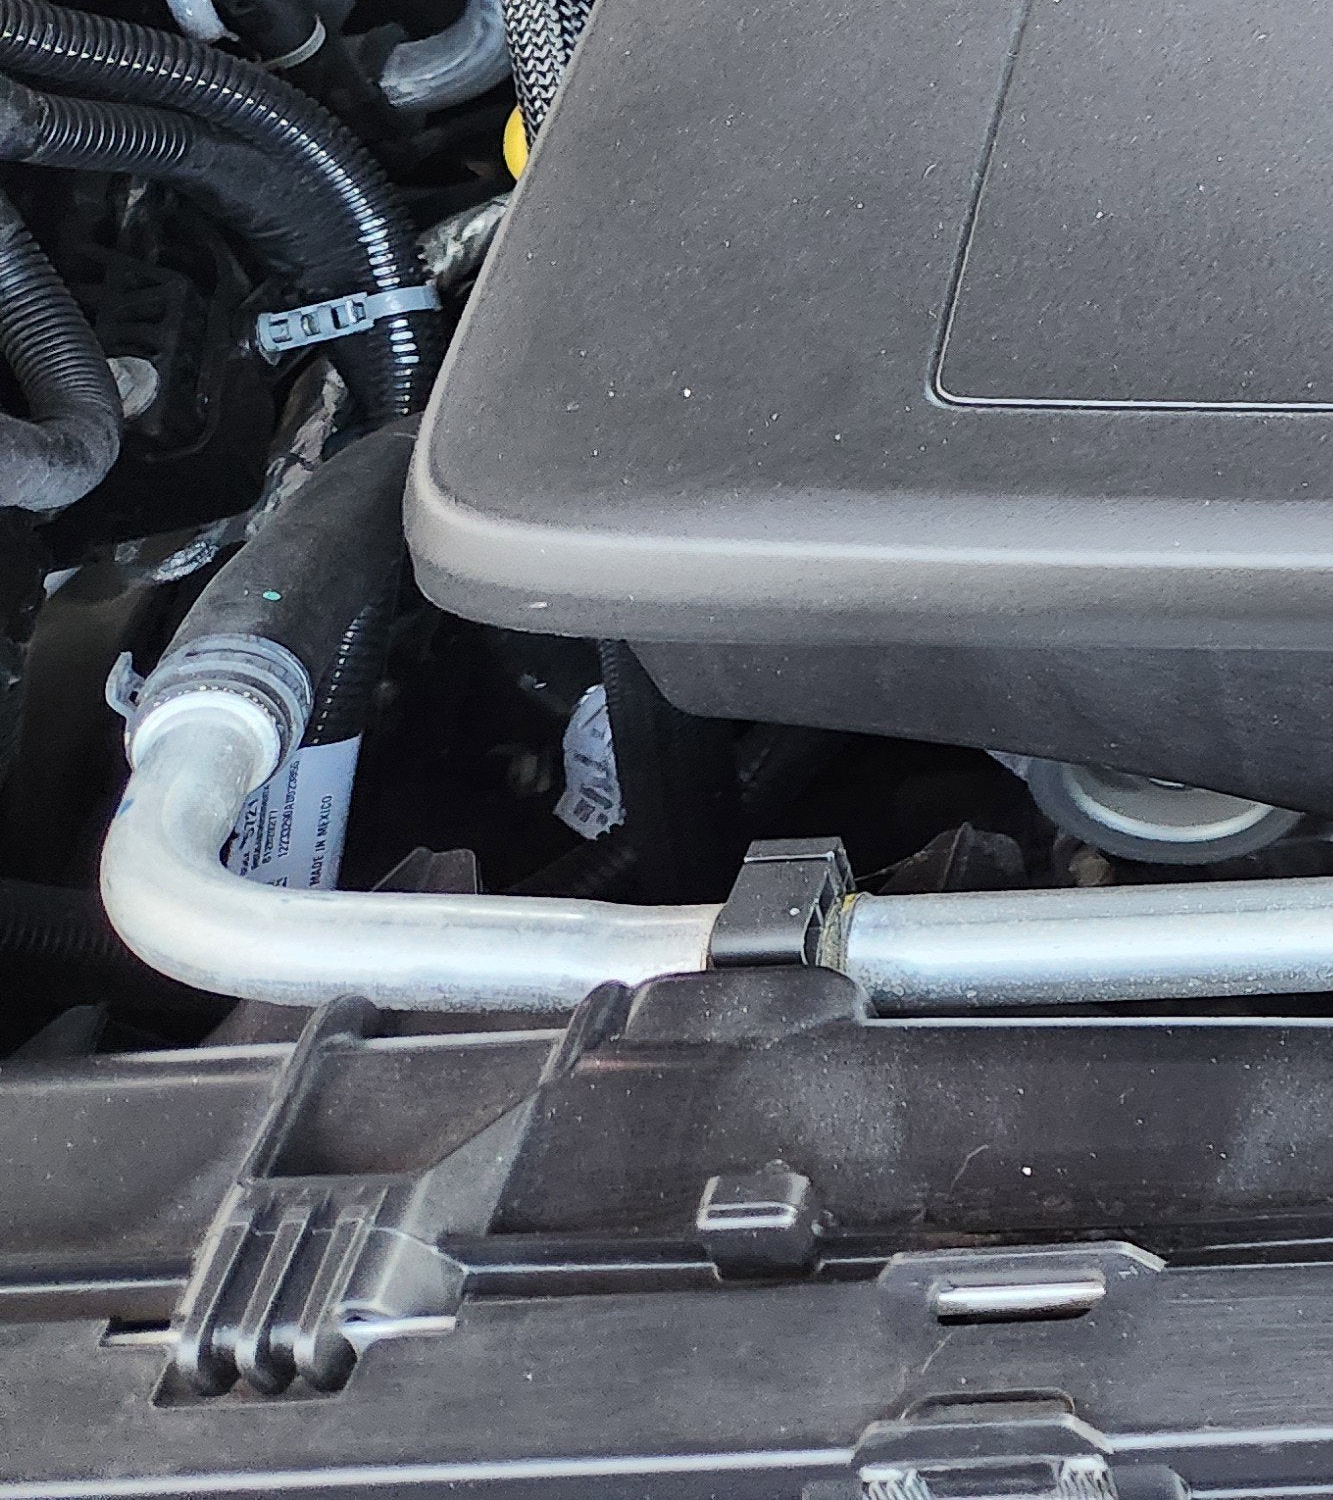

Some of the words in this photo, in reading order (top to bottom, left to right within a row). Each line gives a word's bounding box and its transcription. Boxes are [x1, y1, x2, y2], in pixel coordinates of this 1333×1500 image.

[317, 795, 333, 838] MEXICO
[315, 839, 327, 853] IN
[309, 854, 324, 886] MADE
